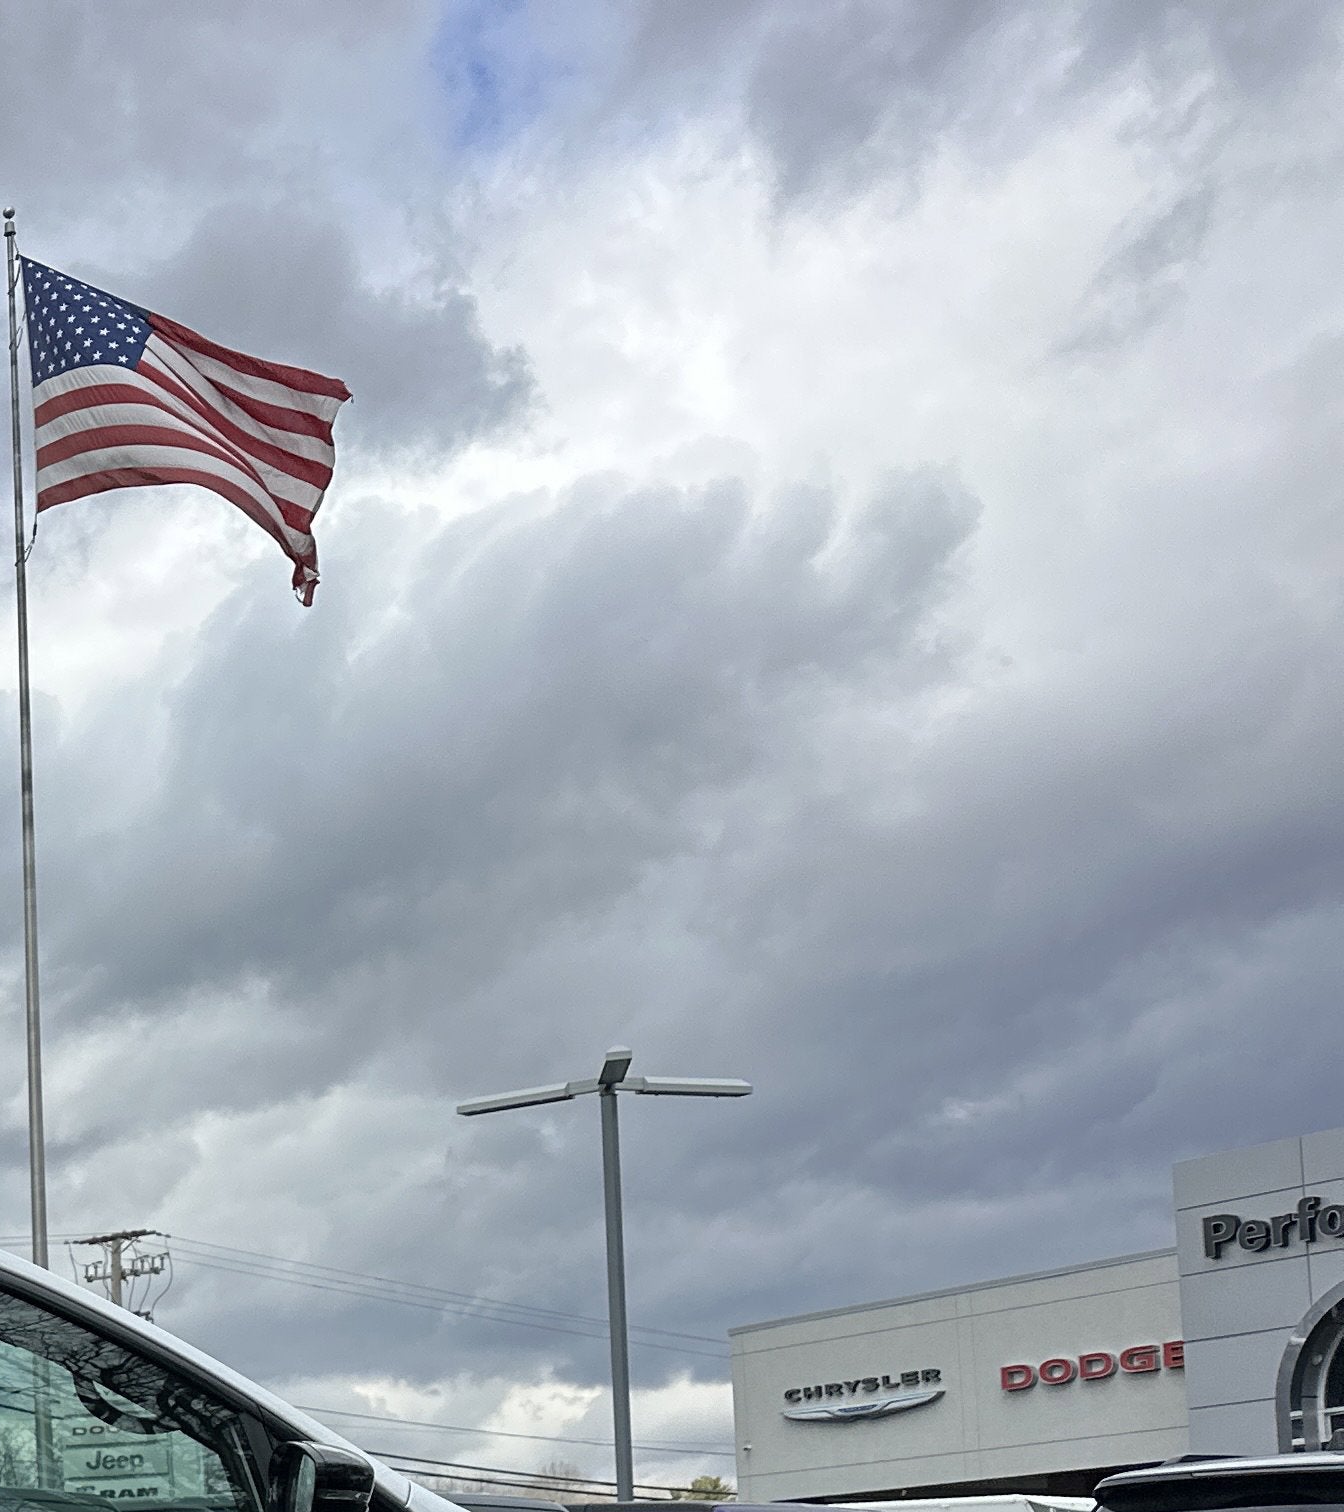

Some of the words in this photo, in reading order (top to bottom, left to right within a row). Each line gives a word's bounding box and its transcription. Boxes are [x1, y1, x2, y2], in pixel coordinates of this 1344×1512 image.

[1202, 1196, 1344, 1259] Perfo
[1000, 1340, 1185, 1391] DODGE
[784, 1368, 942, 1402] CHRYSLER
[85, 1450, 145, 1471] Jeep
[99, 1487, 159, 1499] RAM
